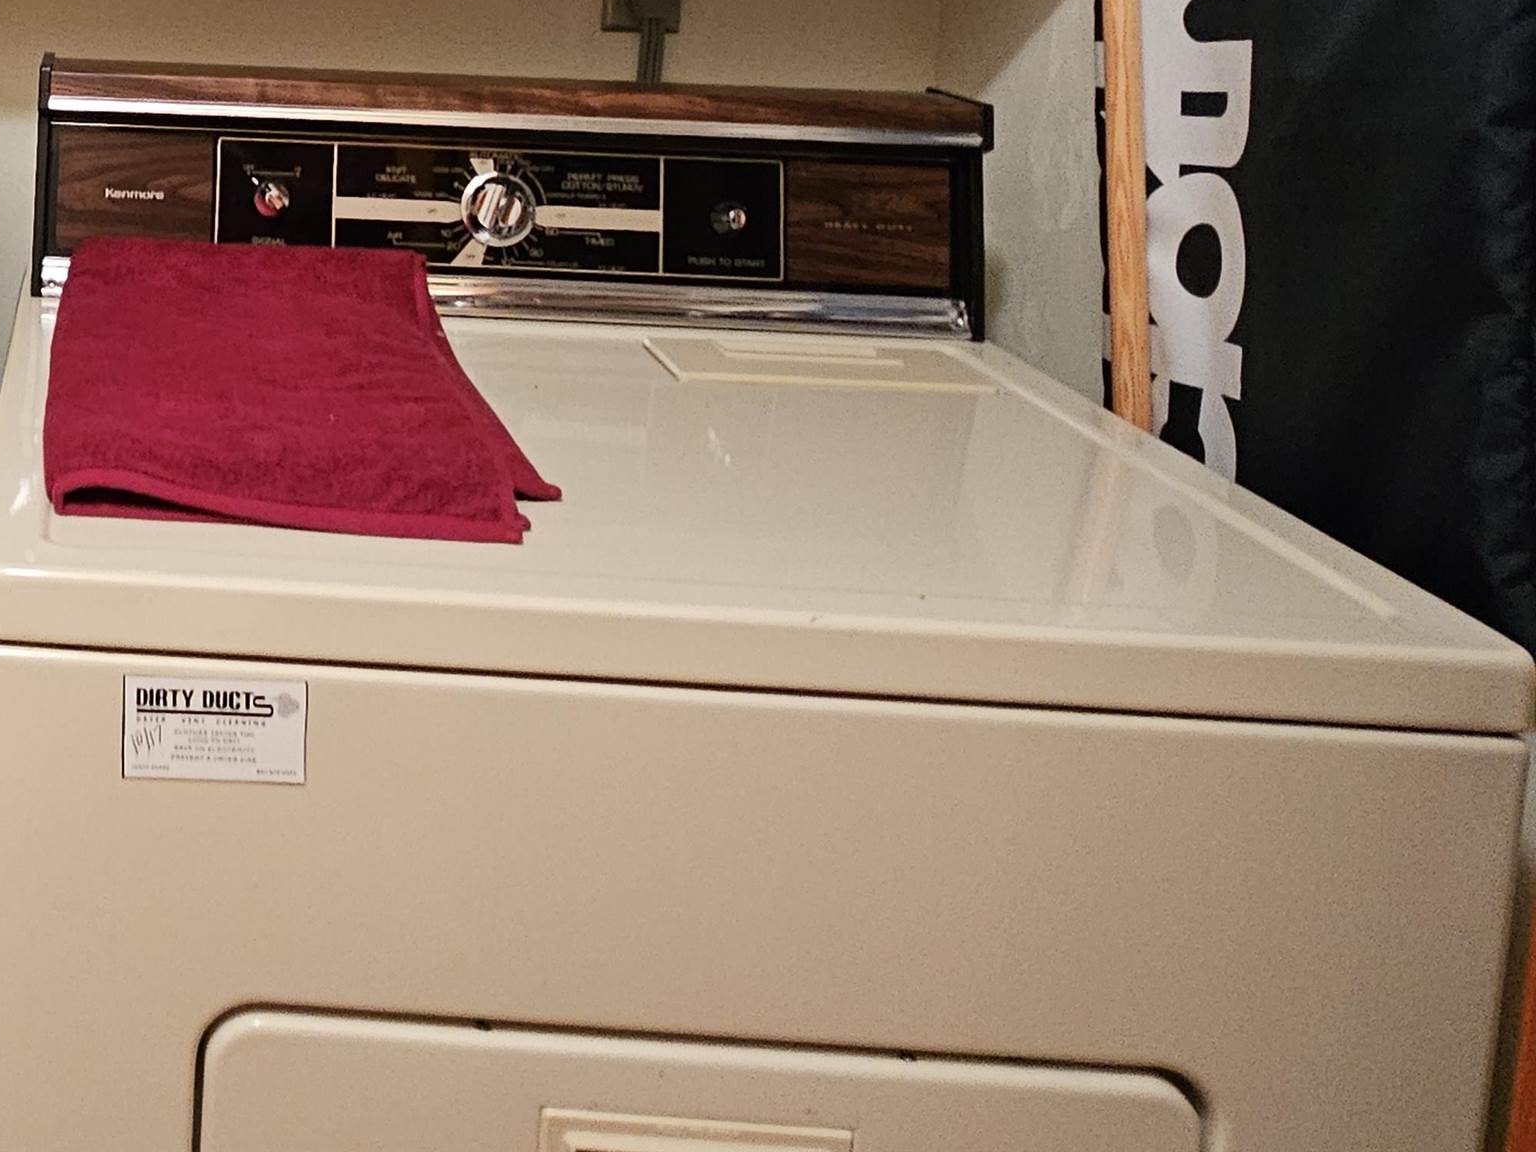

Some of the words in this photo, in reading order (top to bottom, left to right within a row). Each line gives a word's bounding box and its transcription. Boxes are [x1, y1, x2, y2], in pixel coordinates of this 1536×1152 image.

[375, 175, 417, 184] DELICATE
[105, 188, 164, 200] Kenmore
[687, 255, 716, 266] PUSH
[720, 256, 732, 266] TO
[734, 258, 766, 268] START
[136, 687, 194, 708] DIRTY
